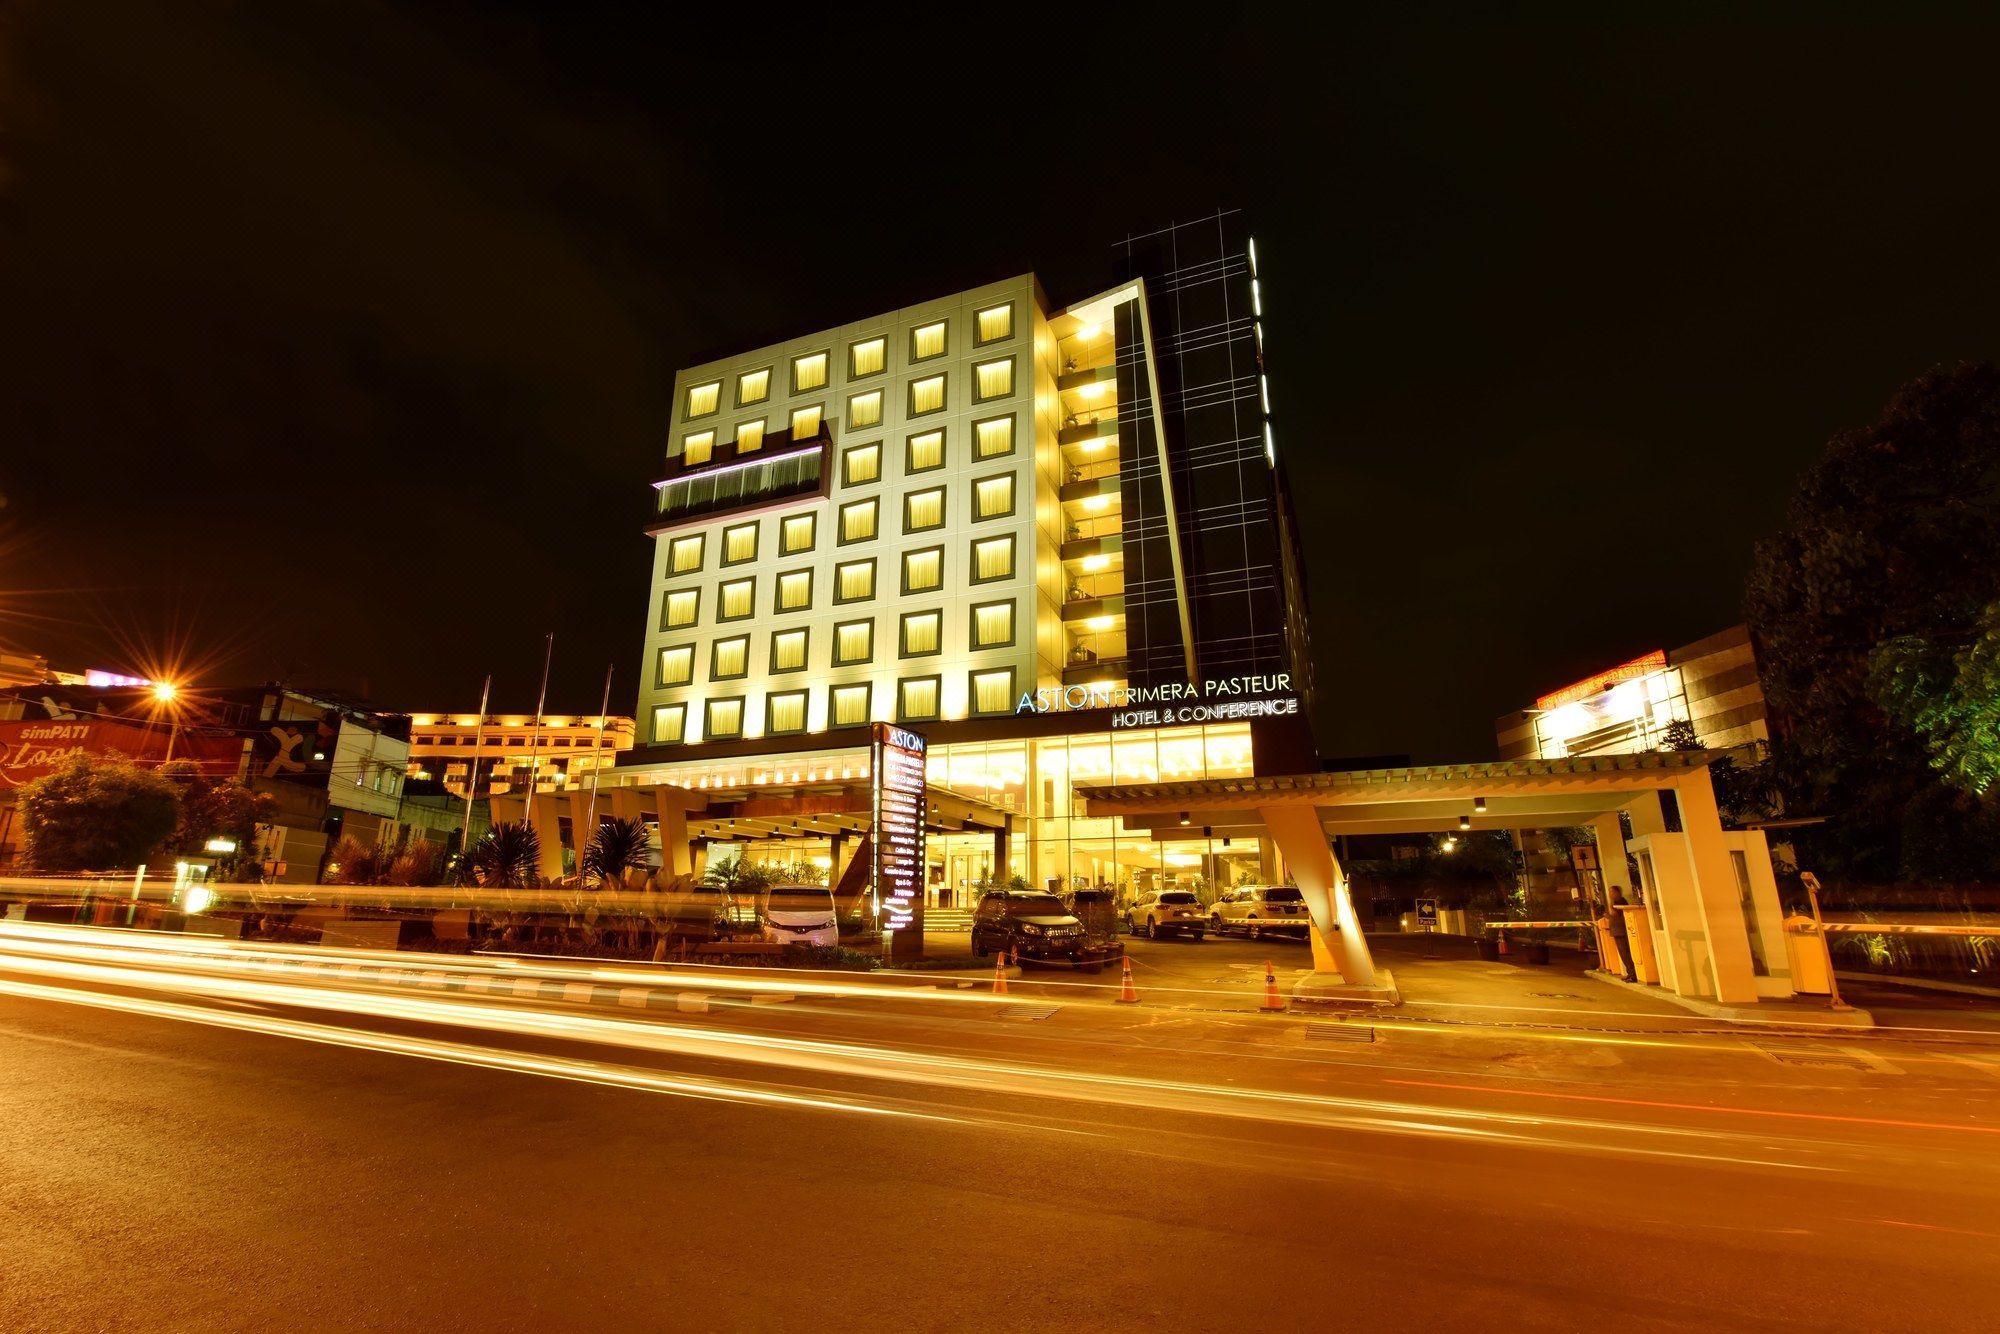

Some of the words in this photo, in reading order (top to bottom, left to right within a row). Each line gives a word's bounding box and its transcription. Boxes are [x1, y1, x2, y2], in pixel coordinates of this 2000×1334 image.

[1016, 685, 1110, 714] ASTON
[1114, 682, 1199, 705] PRIMERA
[1205, 674, 1291, 697] PASTEUR
[1112, 707, 1160, 728] HOTEL
[1163, 706, 1176, 723] &
[1178, 698, 1298, 722] CONFERENCE
[20, 725, 90, 740] simPATI
[889, 729, 924, 752] ASTON
